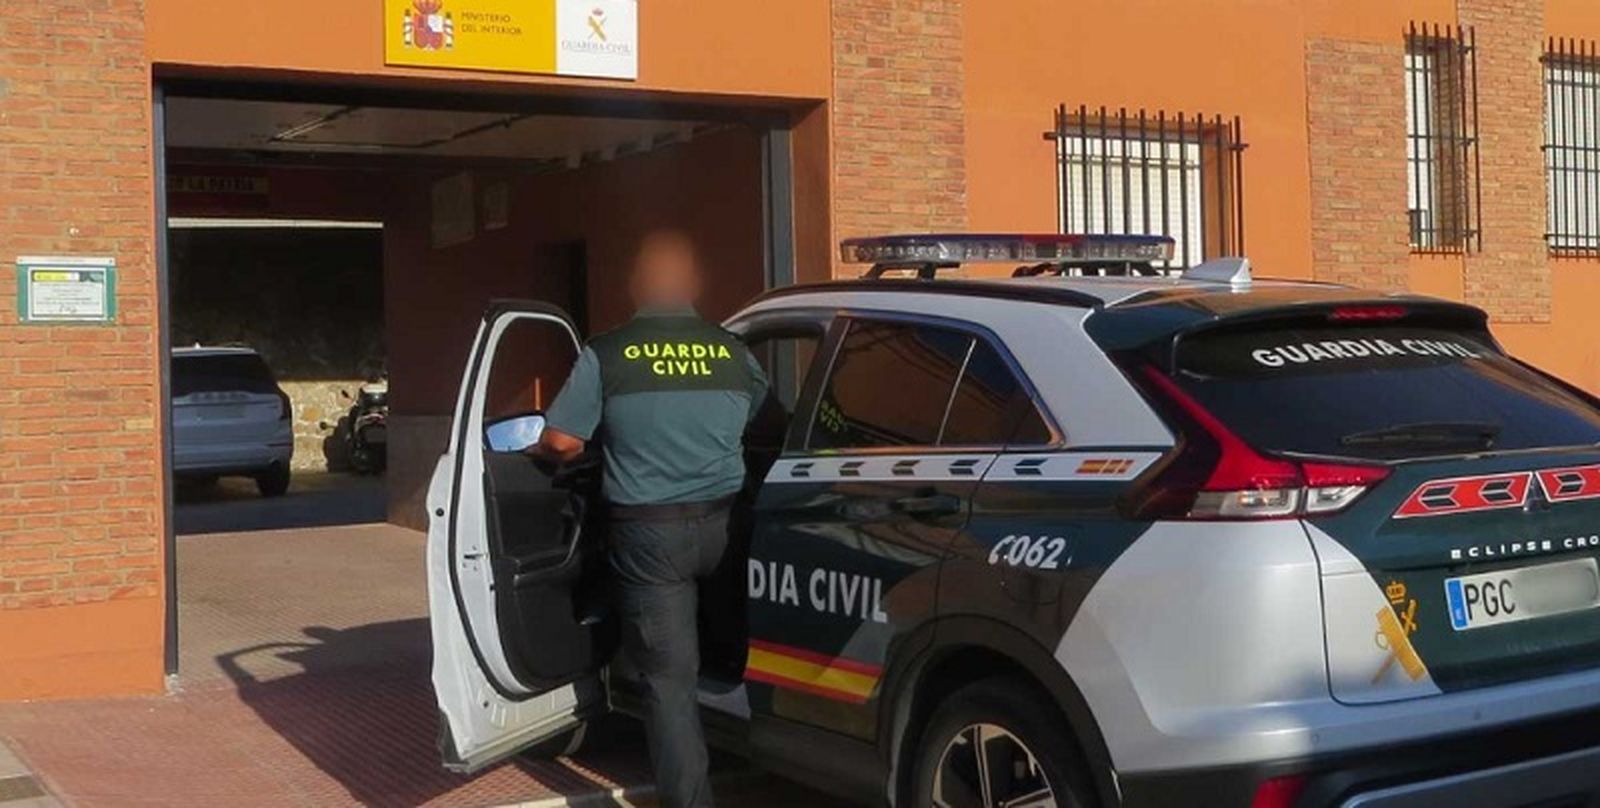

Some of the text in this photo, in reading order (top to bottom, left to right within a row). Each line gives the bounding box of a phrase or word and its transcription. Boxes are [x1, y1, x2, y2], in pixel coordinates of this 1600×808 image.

[461, 11, 511, 23] MINISTERIO
[461, 23, 522, 36] DEL INTERIOR
[624, 343, 731, 360] GUARDIA
[1251, 338, 1482, 368] GUARDIA CIVIL
[652, 360, 712, 375] CIVIL
[1008, 535, 1067, 569] 062
[1451, 540, 1552, 559] ECLIPSE
[809, 567, 889, 624] CIVIL
[1464, 579, 1516, 620] PGC
